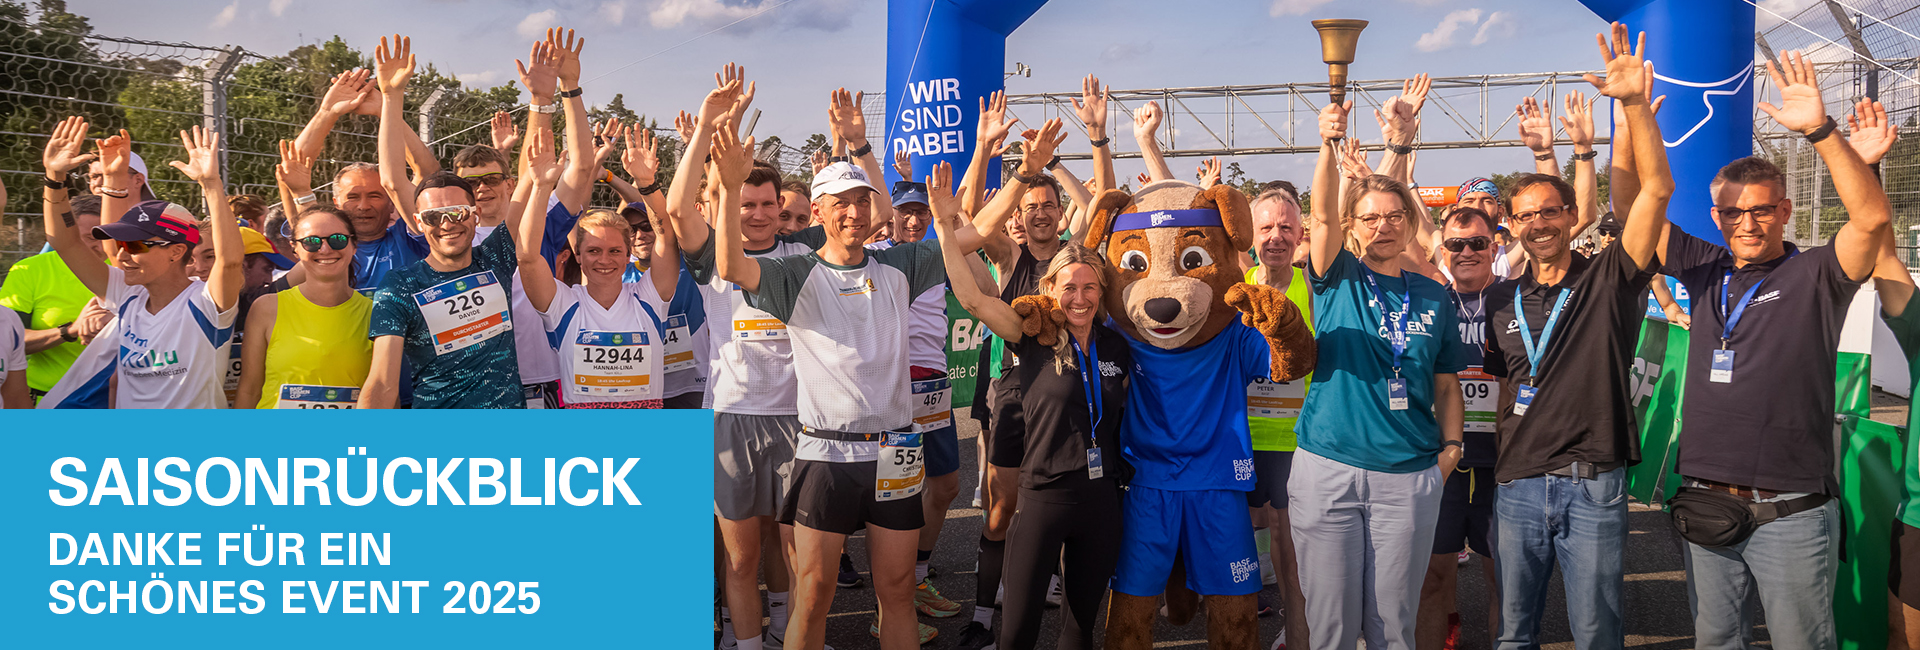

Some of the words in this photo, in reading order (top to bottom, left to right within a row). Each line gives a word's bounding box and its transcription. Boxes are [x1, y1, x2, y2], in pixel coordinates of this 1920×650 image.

[909, 78, 961, 104] WIR
[901, 105, 963, 132] SIND
[893, 130, 965, 158] DABEI
[444, 290, 485, 315] 226
[459, 309, 480, 320] DAVIDE
[452, 321, 489, 336] DURCHSTARTER
[583, 347, 644, 363] 12944
[226, 361, 242, 377] 9
[947, 365, 966, 380] ate
[924, 392, 943, 406] 467
[894, 449, 923, 465] 554
[1233, 458, 1253, 467] BASF
[1235, 473, 1252, 481] CUP
[1230, 558, 1250, 570] BASF
[1231, 561, 1258, 577] FIRMEN
[1233, 572, 1250, 583] CUP
